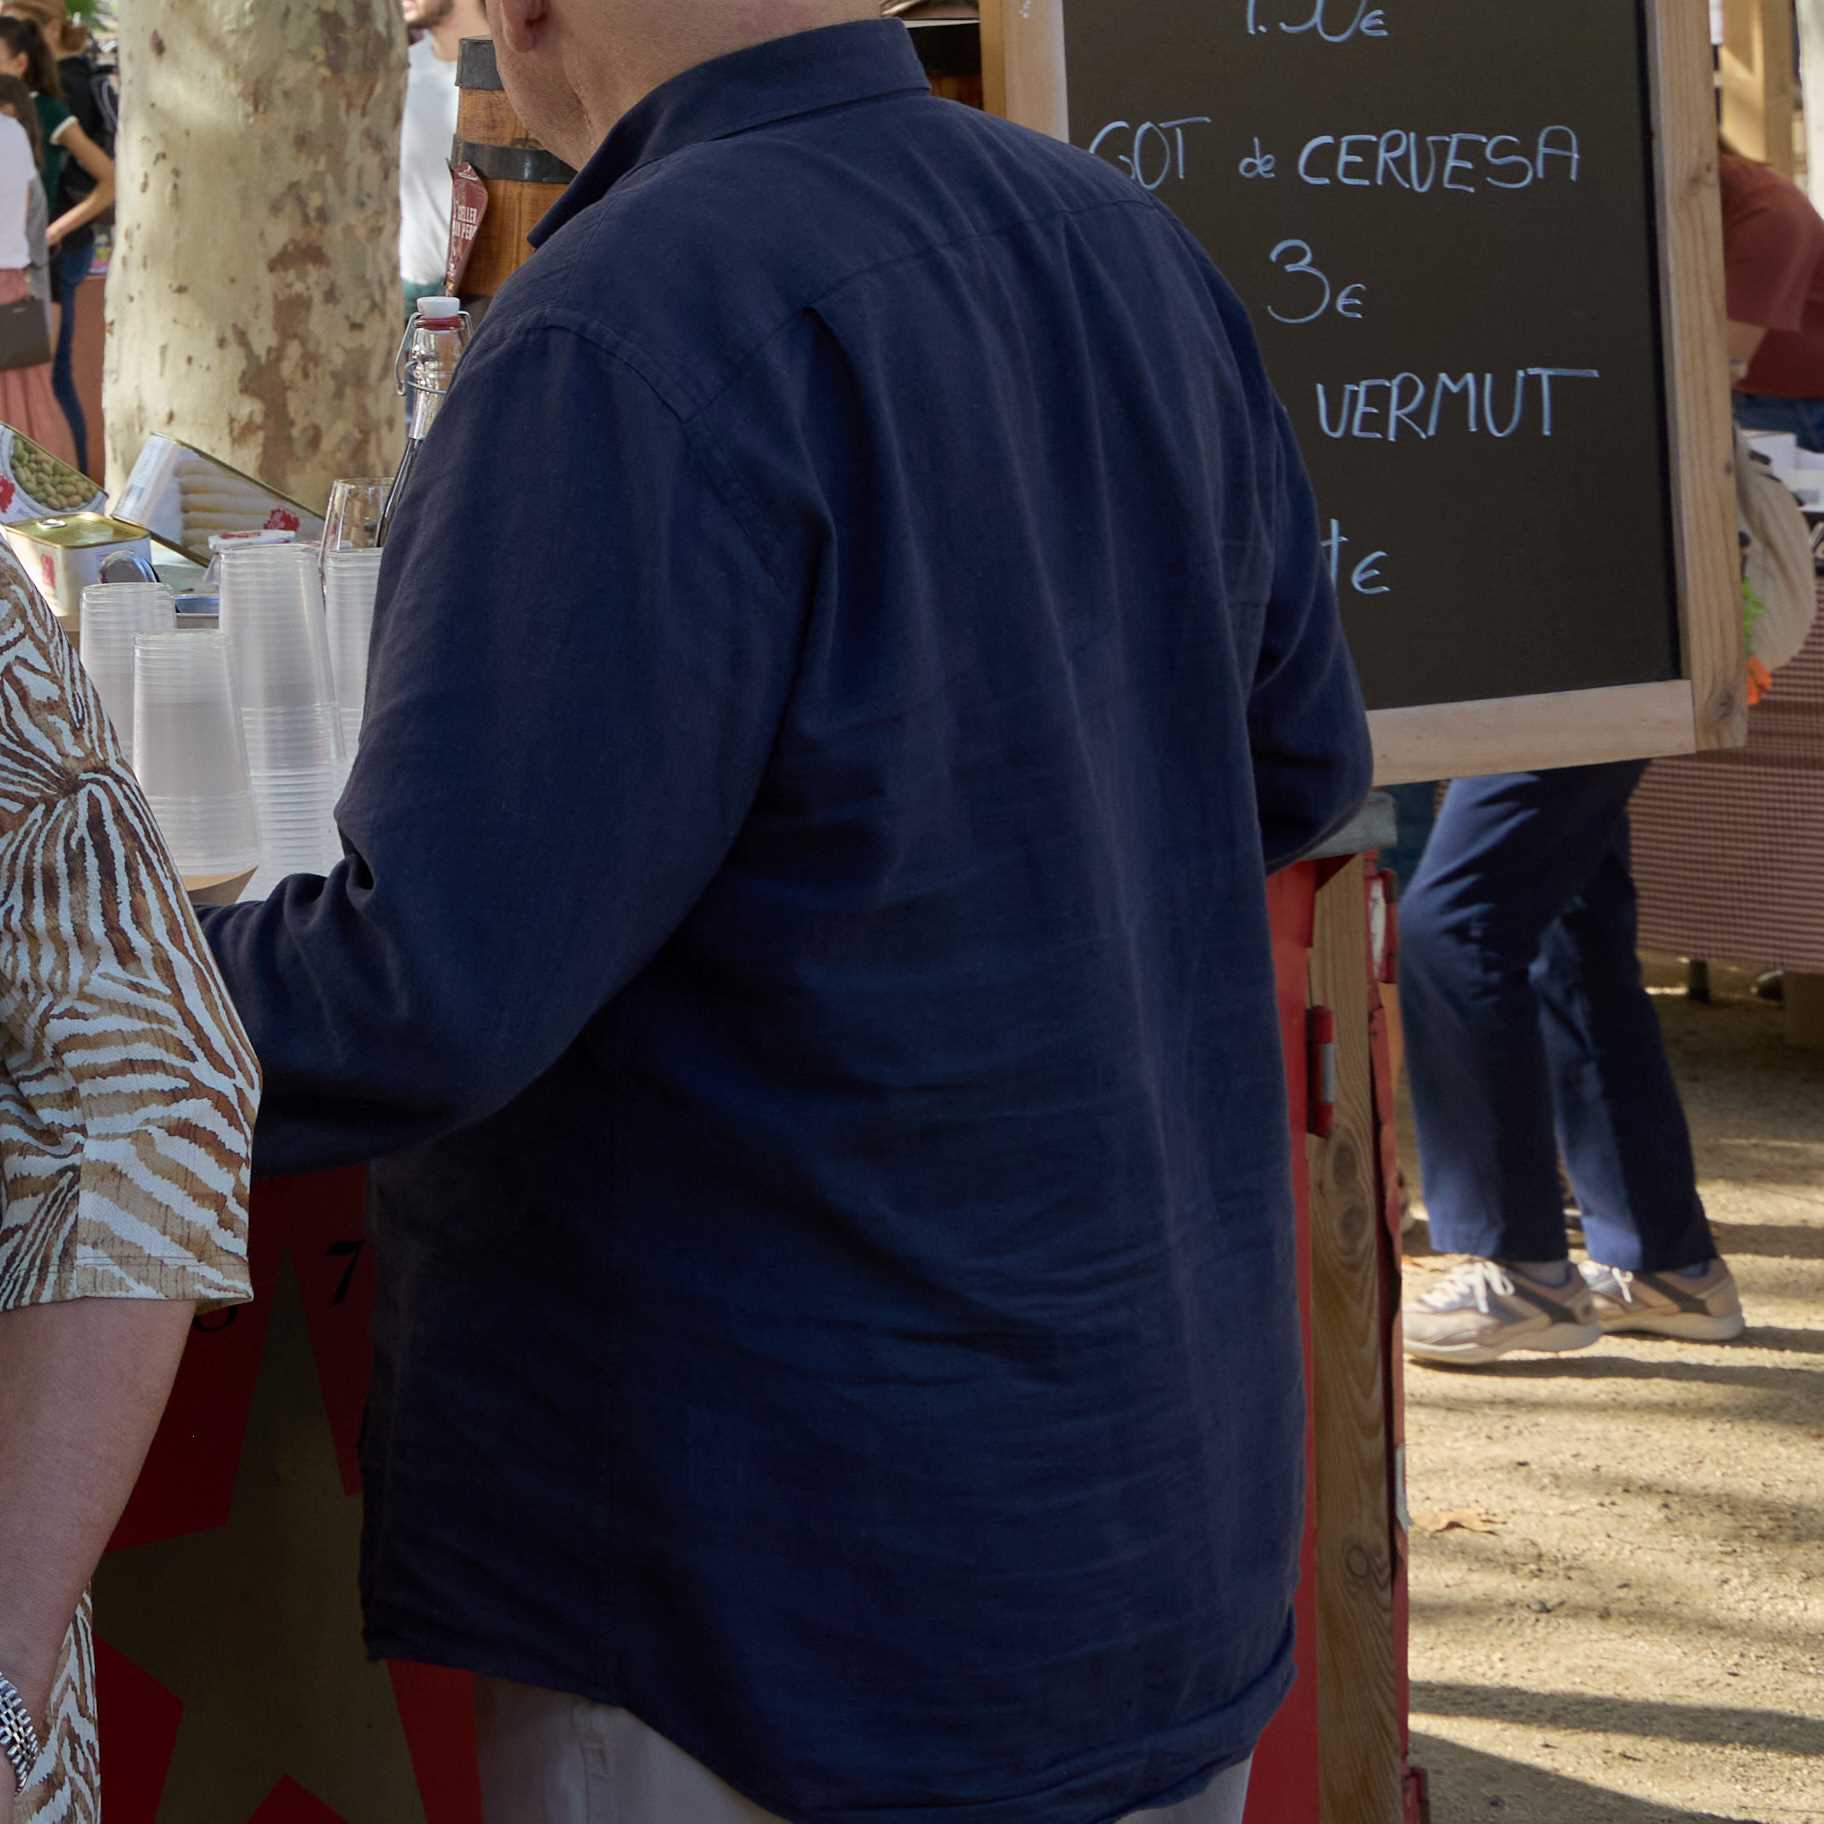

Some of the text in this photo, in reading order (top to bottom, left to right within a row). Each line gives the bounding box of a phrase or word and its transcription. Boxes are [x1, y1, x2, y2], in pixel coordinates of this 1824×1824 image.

[1088, 116, 1581, 193] GOT de CERVESA
[1315, 366, 1601, 442] VERMUT
